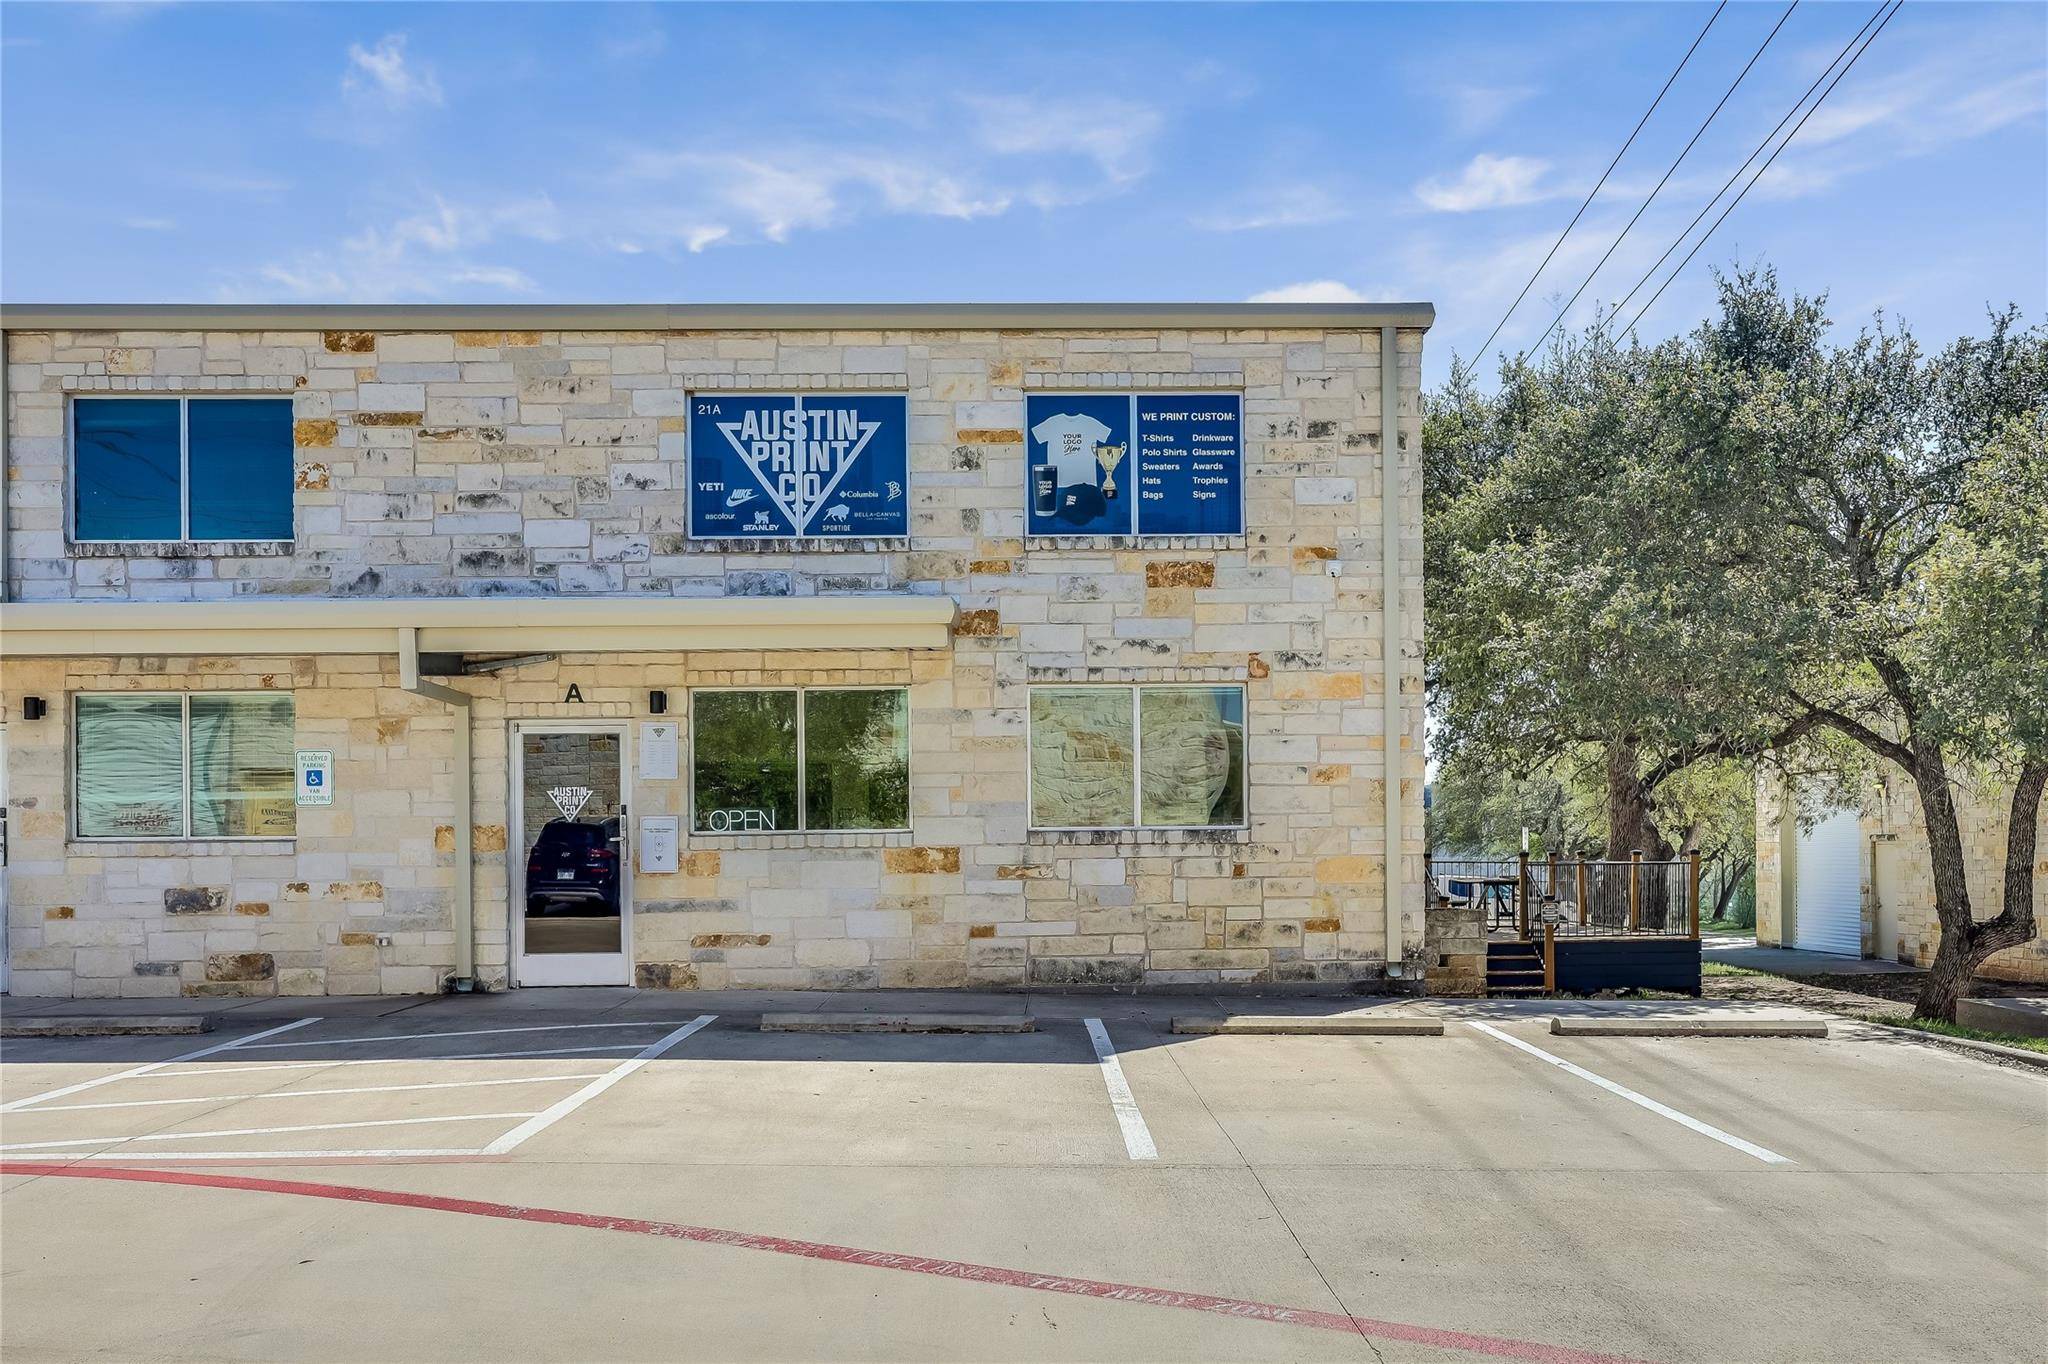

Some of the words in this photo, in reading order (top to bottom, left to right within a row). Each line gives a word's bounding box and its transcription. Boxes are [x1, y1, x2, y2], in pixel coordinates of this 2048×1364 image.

[698, 405, 721, 415] 21A
[1142, 413, 1157, 421] WE
[1160, 413, 1188, 421] PRINT
[1191, 413, 1235, 421] CUSTOM:
[740, 410, 858, 440] AUSTIN
[1064, 445, 1081, 455] Here
[752, 441, 849, 472] PRINT
[1192, 477, 1228, 486] Trophies
[698, 483, 724, 492] YETI
[778, 473, 820, 502] CO
[731, 489, 753, 500] NIKE
[847, 490, 879, 498] Columbia
[1142, 491, 1164, 500] Bags
[1192, 491, 1216, 500] Signs
[564, 683, 584, 703] A
[553, 787, 587, 796] AUSTIN
[556, 796, 584, 805] PRINT
[565, 806, 576, 814] CO
[709, 809, 775, 832] OPEN
